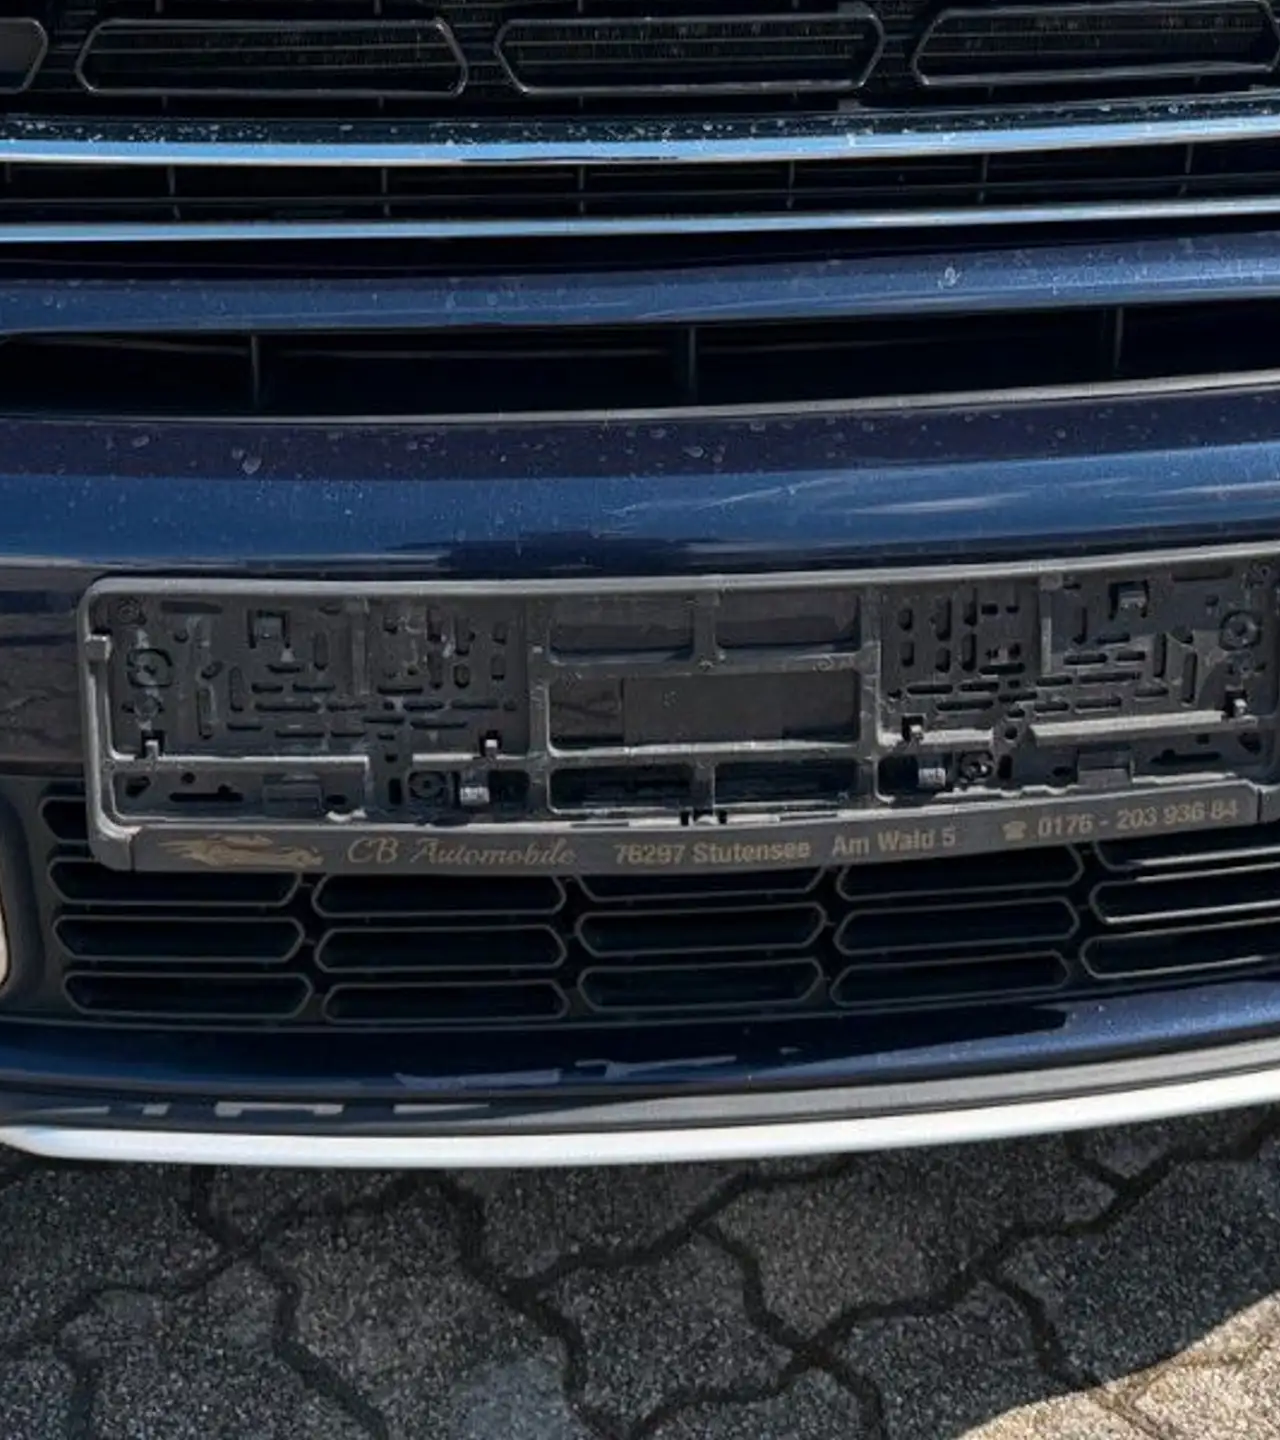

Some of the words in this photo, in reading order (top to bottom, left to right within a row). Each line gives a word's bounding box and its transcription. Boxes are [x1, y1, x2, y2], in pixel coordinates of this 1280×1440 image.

[347, 835, 400, 865] CB
[410, 834, 577, 866] Automobile
[614, 842, 683, 864] 76297
[692, 837, 812, 863] Stutensee
[831, 832, 869, 857] Am
[877, 827, 936, 851] Wald
[942, 824, 956, 848] 5
[1038, 815, 1094, 838] 0176
[1116, 806, 1157, 830] 203
[1164, 800, 1206, 826] 936
[1210, 798, 1239, 820] 84
